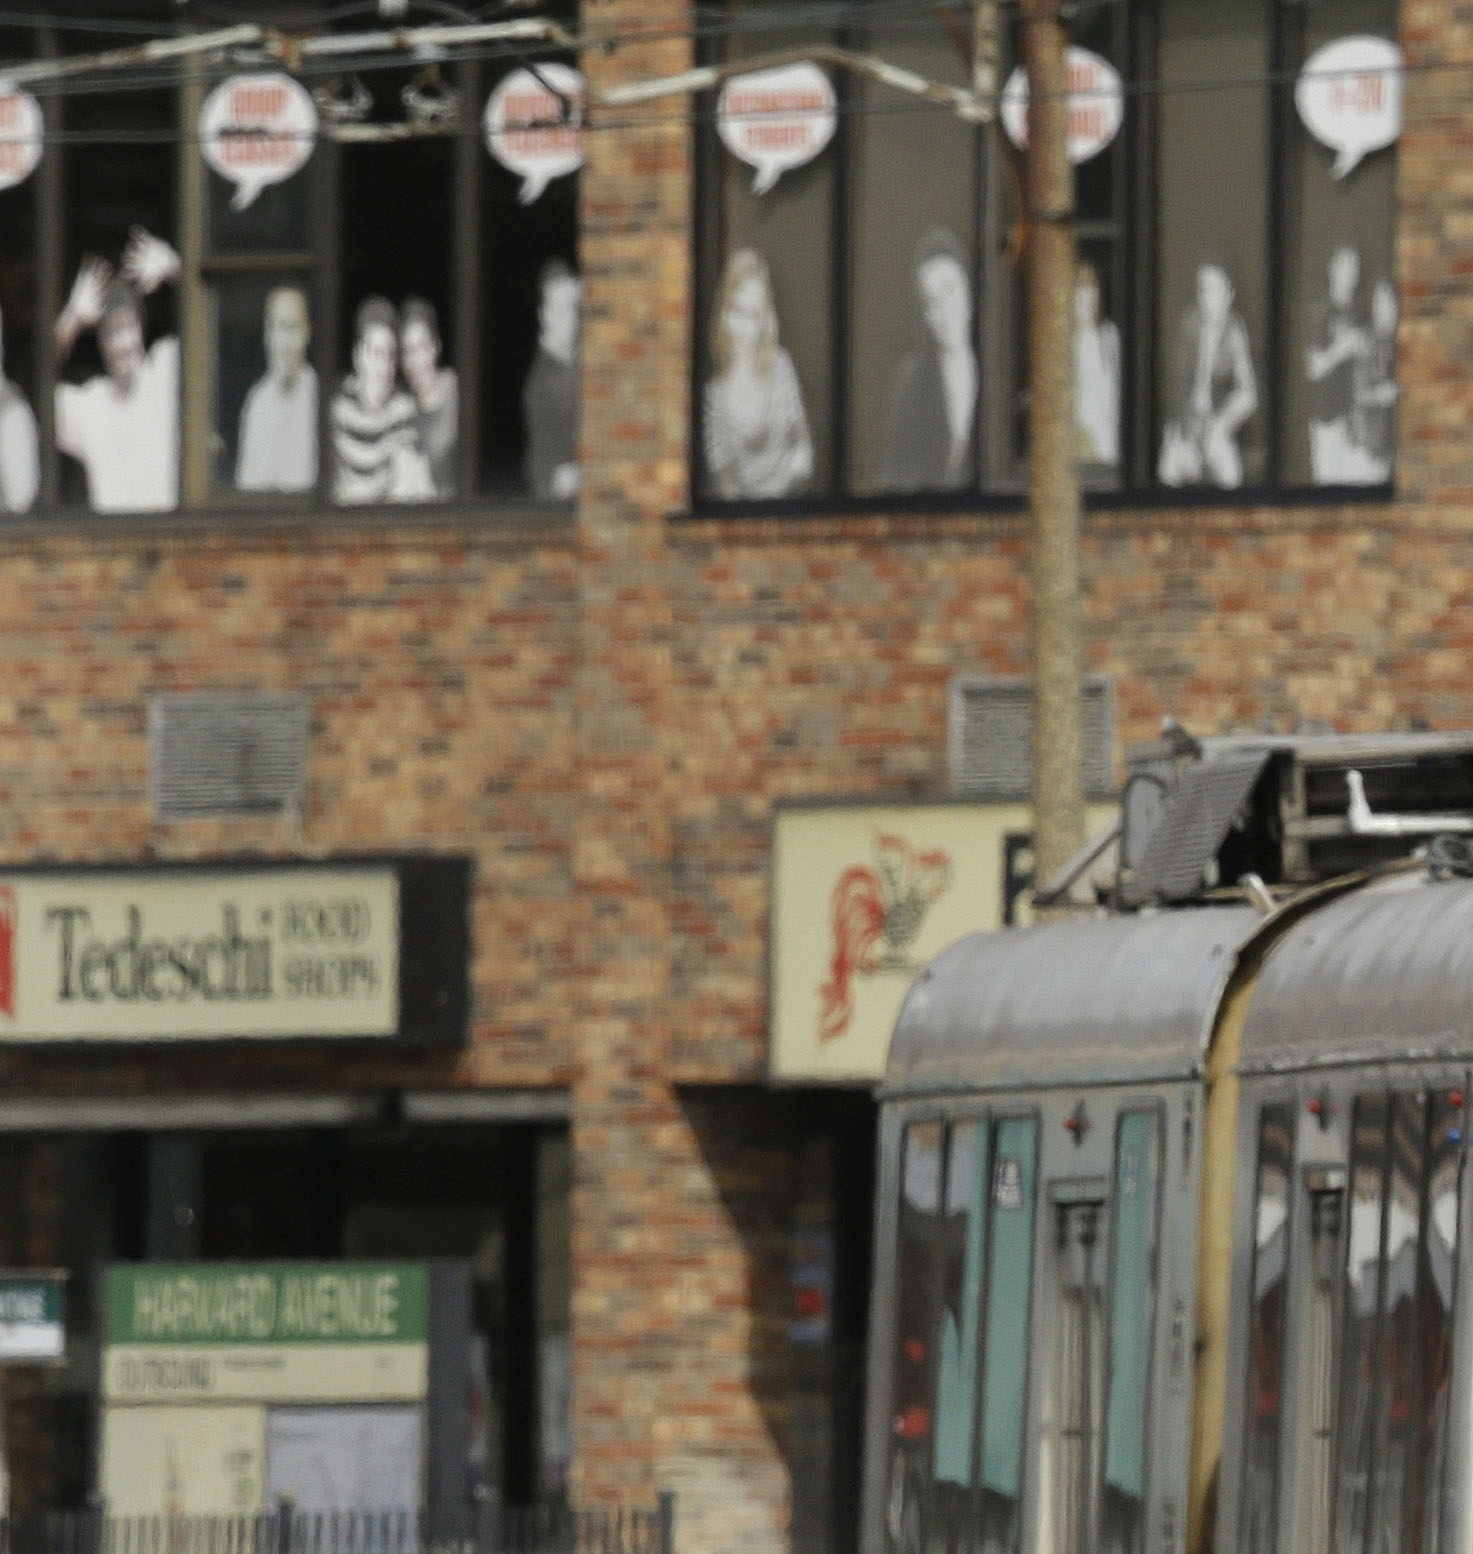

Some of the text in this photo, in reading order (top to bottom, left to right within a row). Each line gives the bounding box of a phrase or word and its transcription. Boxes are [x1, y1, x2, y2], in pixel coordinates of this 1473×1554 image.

[280, 897, 372, 943] FOOD
[45, 904, 272, 1002] Tedeschi
[284, 952, 379, 998] SHOPS
[132, 1273, 400, 1337] HARVARD AVENUE
